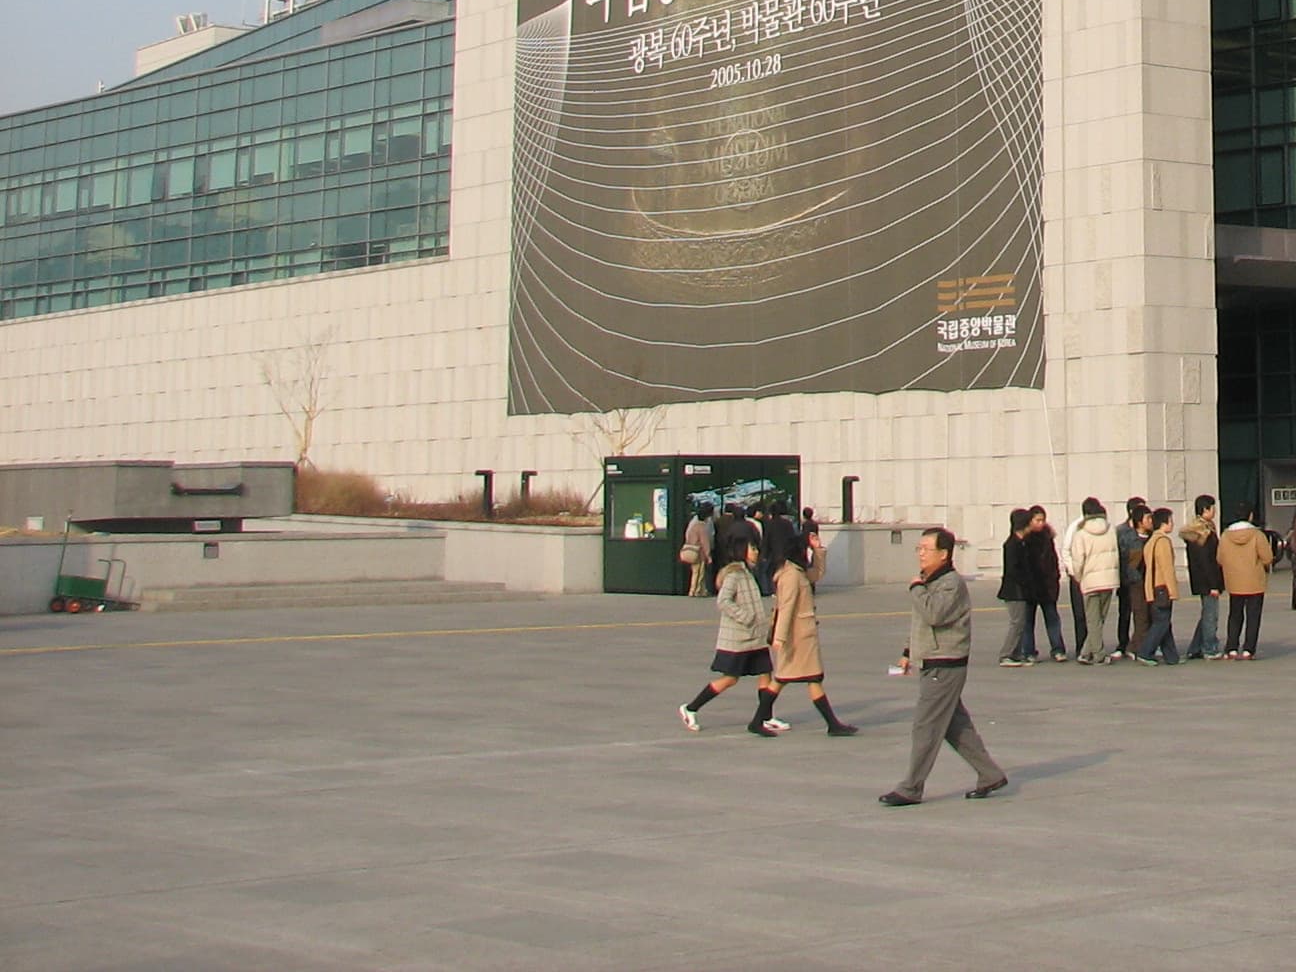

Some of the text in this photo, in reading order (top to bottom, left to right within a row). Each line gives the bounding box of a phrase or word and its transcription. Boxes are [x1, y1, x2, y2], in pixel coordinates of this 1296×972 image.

[628, 29, 668, 73] 광복
[671, 9, 736, 58] 60주년,
[710, 53, 783, 89] 2005.10.28
[937, 314, 1016, 340] 국립중앙박물관
